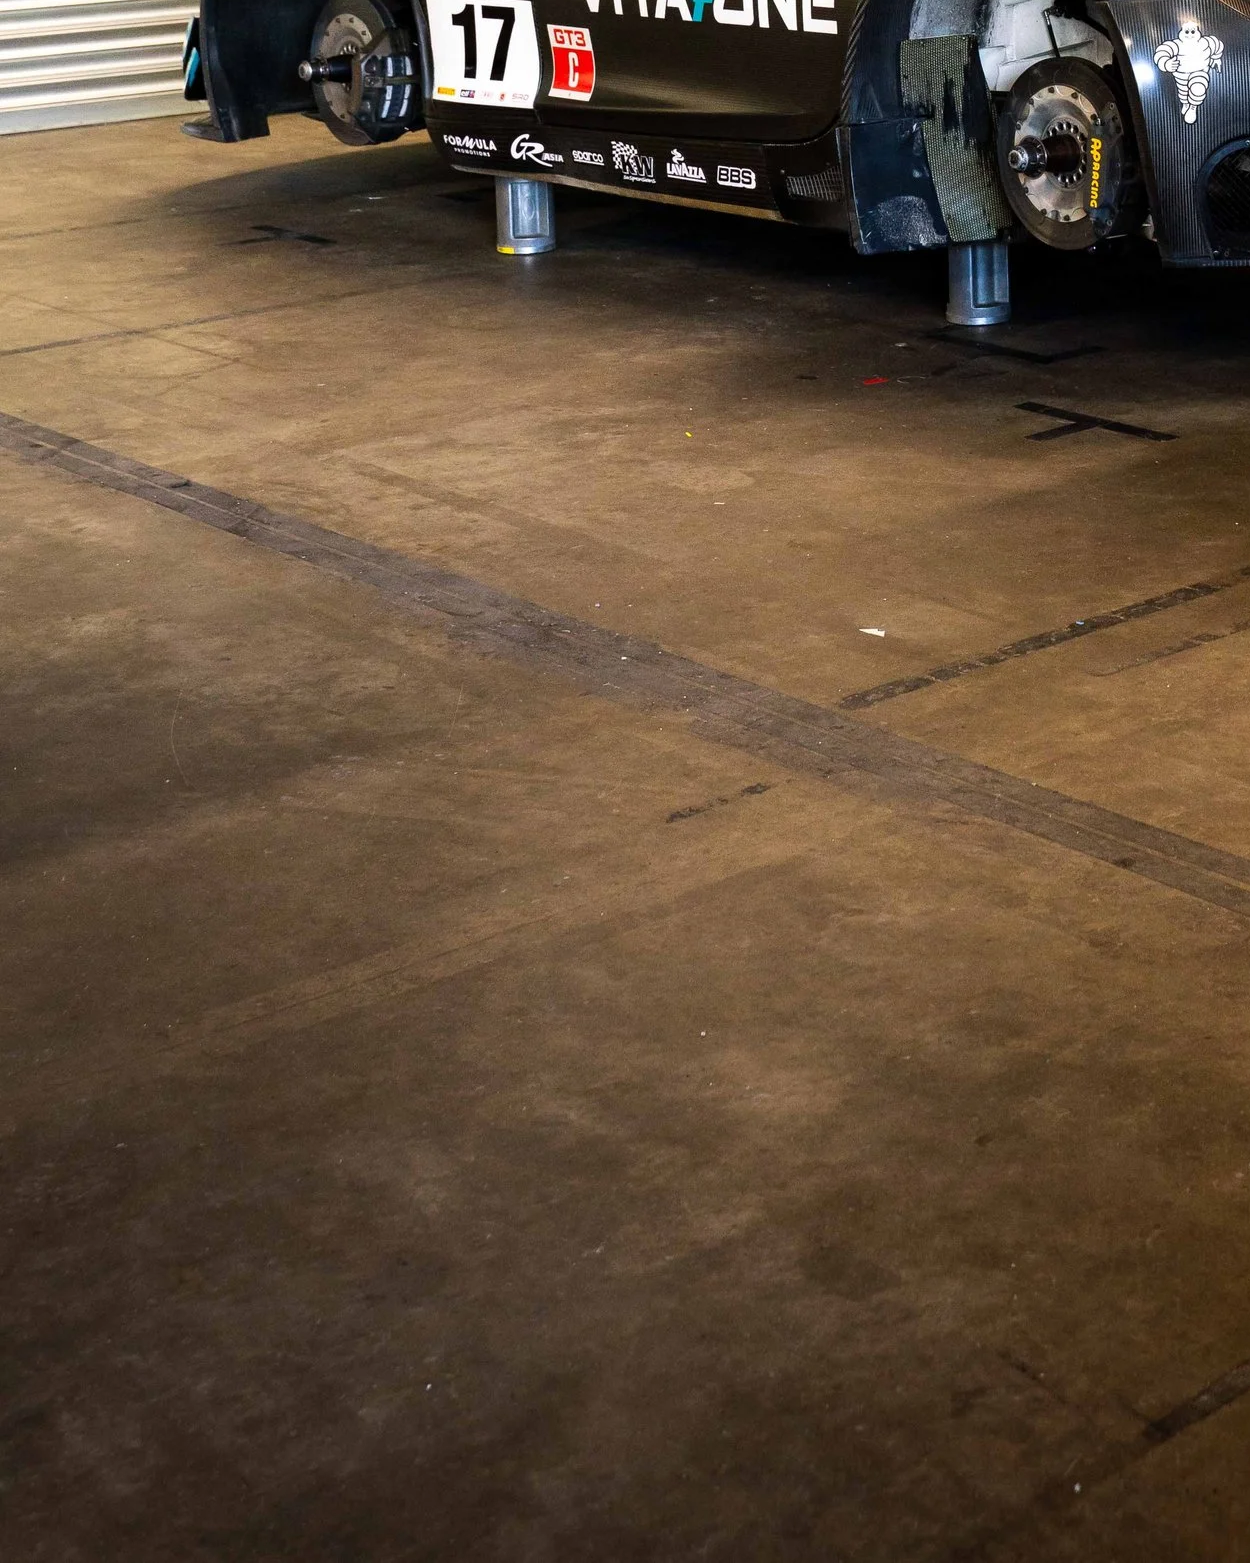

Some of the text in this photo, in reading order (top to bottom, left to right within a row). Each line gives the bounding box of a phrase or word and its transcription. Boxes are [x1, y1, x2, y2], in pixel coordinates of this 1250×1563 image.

[451, 4, 516, 82] 17
[553, 29, 586, 47] GT3
[568, 52, 579, 88] C
[443, 134, 497, 151] FORMULA
[454, 147, 491, 157] PROMOTIONS
[542, 153, 564, 163] ASIA
[666, 162, 706, 180] LAVAZZA
[717, 166, 755, 188] BBS
